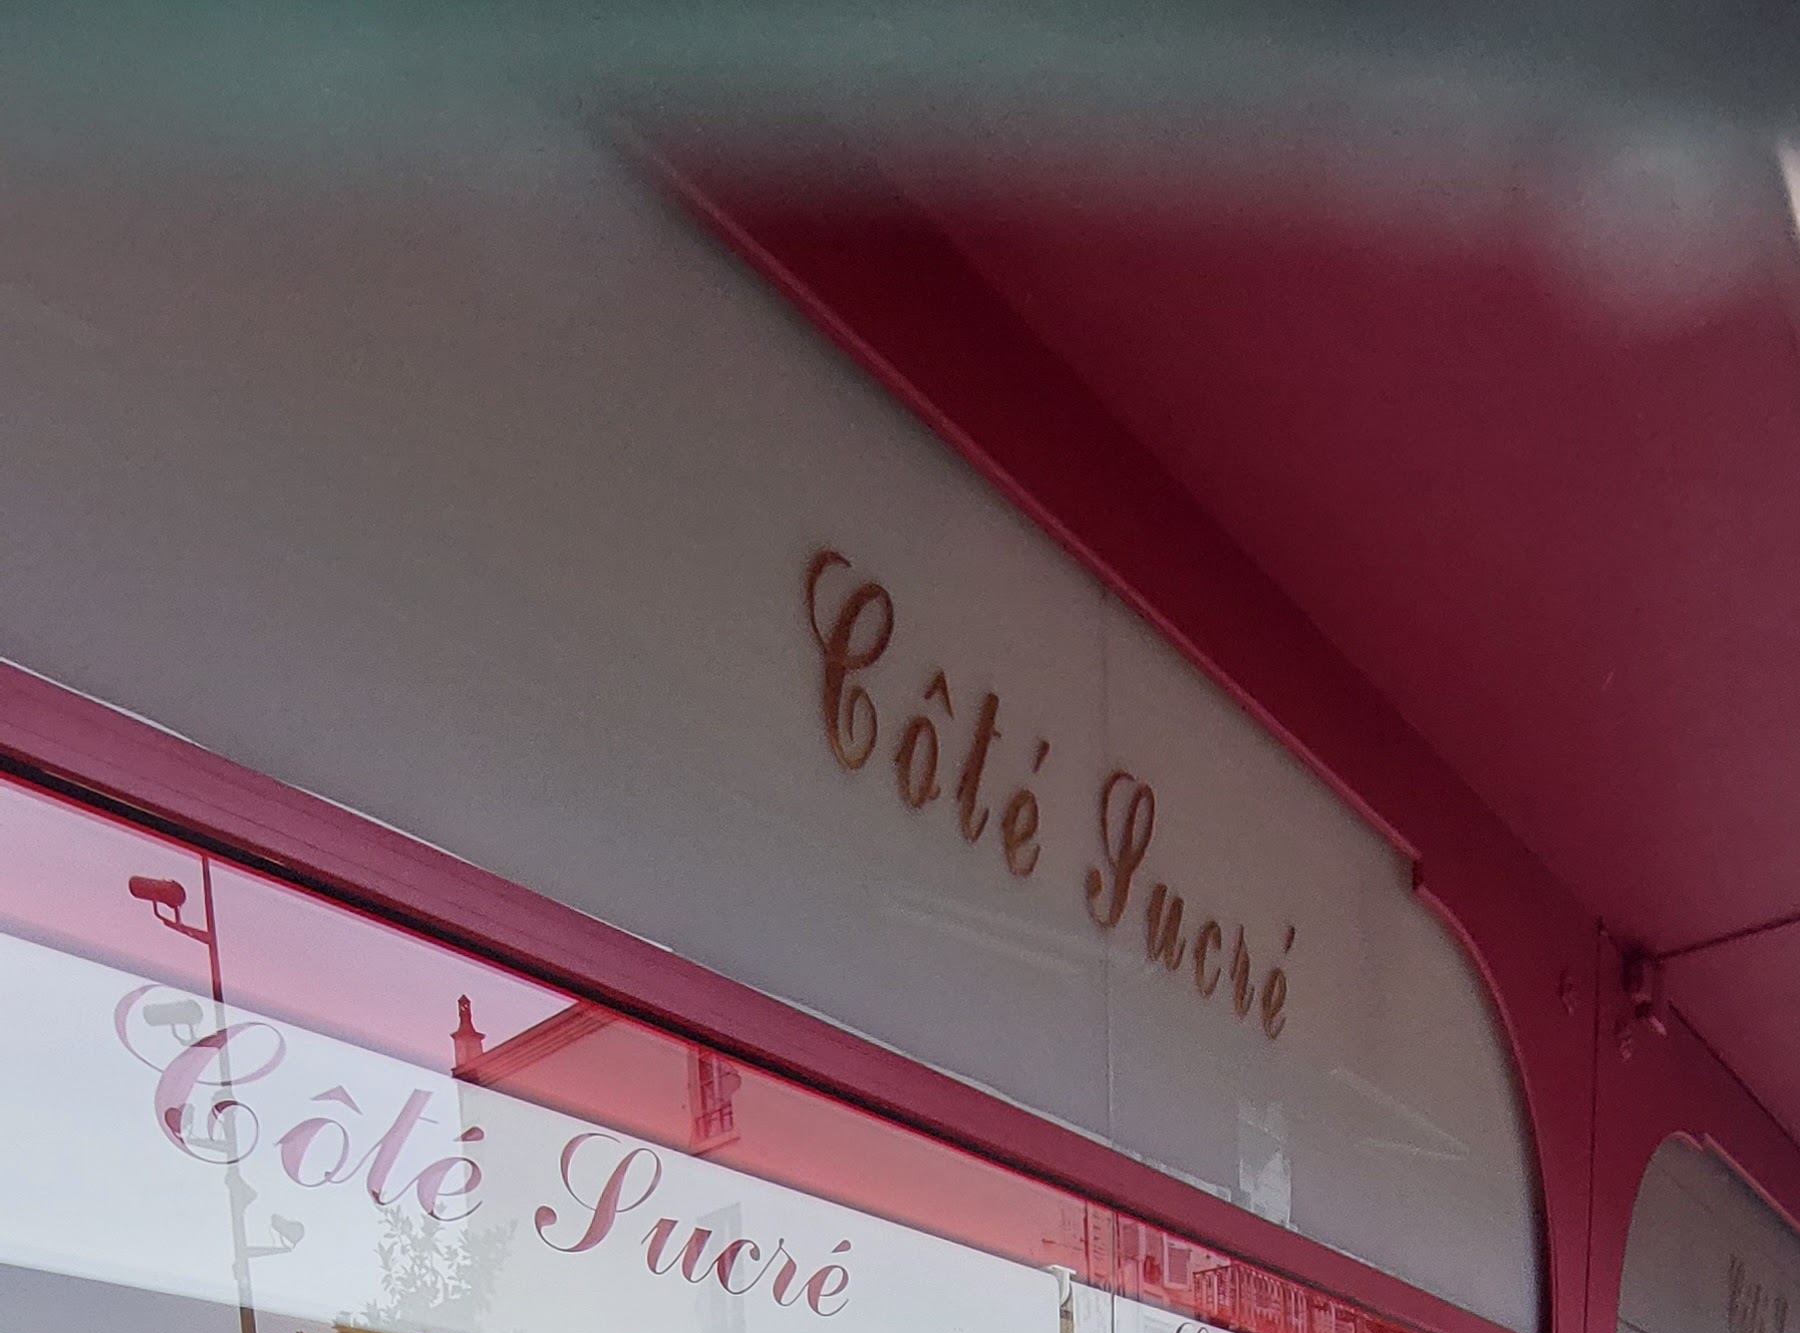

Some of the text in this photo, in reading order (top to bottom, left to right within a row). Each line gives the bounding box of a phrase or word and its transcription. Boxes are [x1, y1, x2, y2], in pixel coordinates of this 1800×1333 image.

[804, 550, 1296, 1041] Côté Sucré
[114, 983, 852, 1317] Côté Sucré
